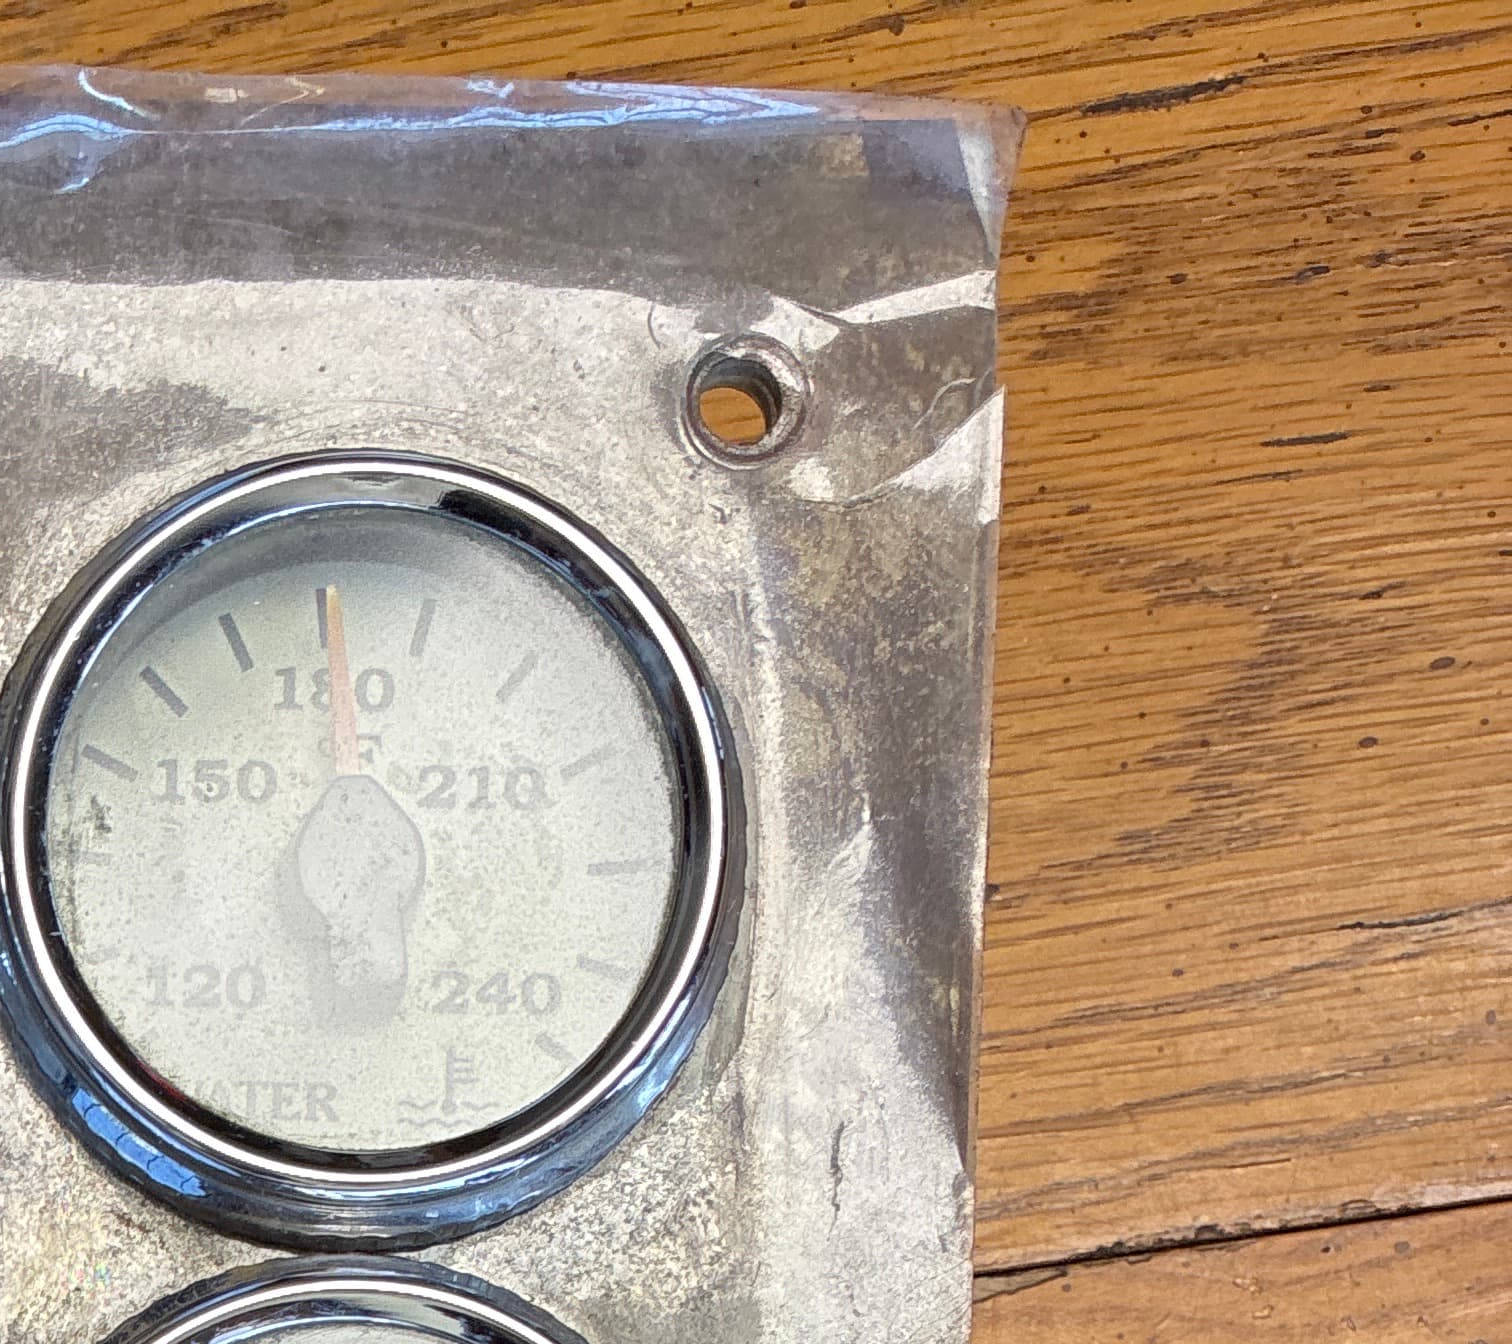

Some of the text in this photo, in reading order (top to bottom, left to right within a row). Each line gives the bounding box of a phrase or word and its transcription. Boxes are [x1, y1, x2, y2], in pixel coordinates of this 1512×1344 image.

[156, 757, 277, 804] 150
[418, 764, 548, 812] 210
[429, 969, 563, 1017] 240
